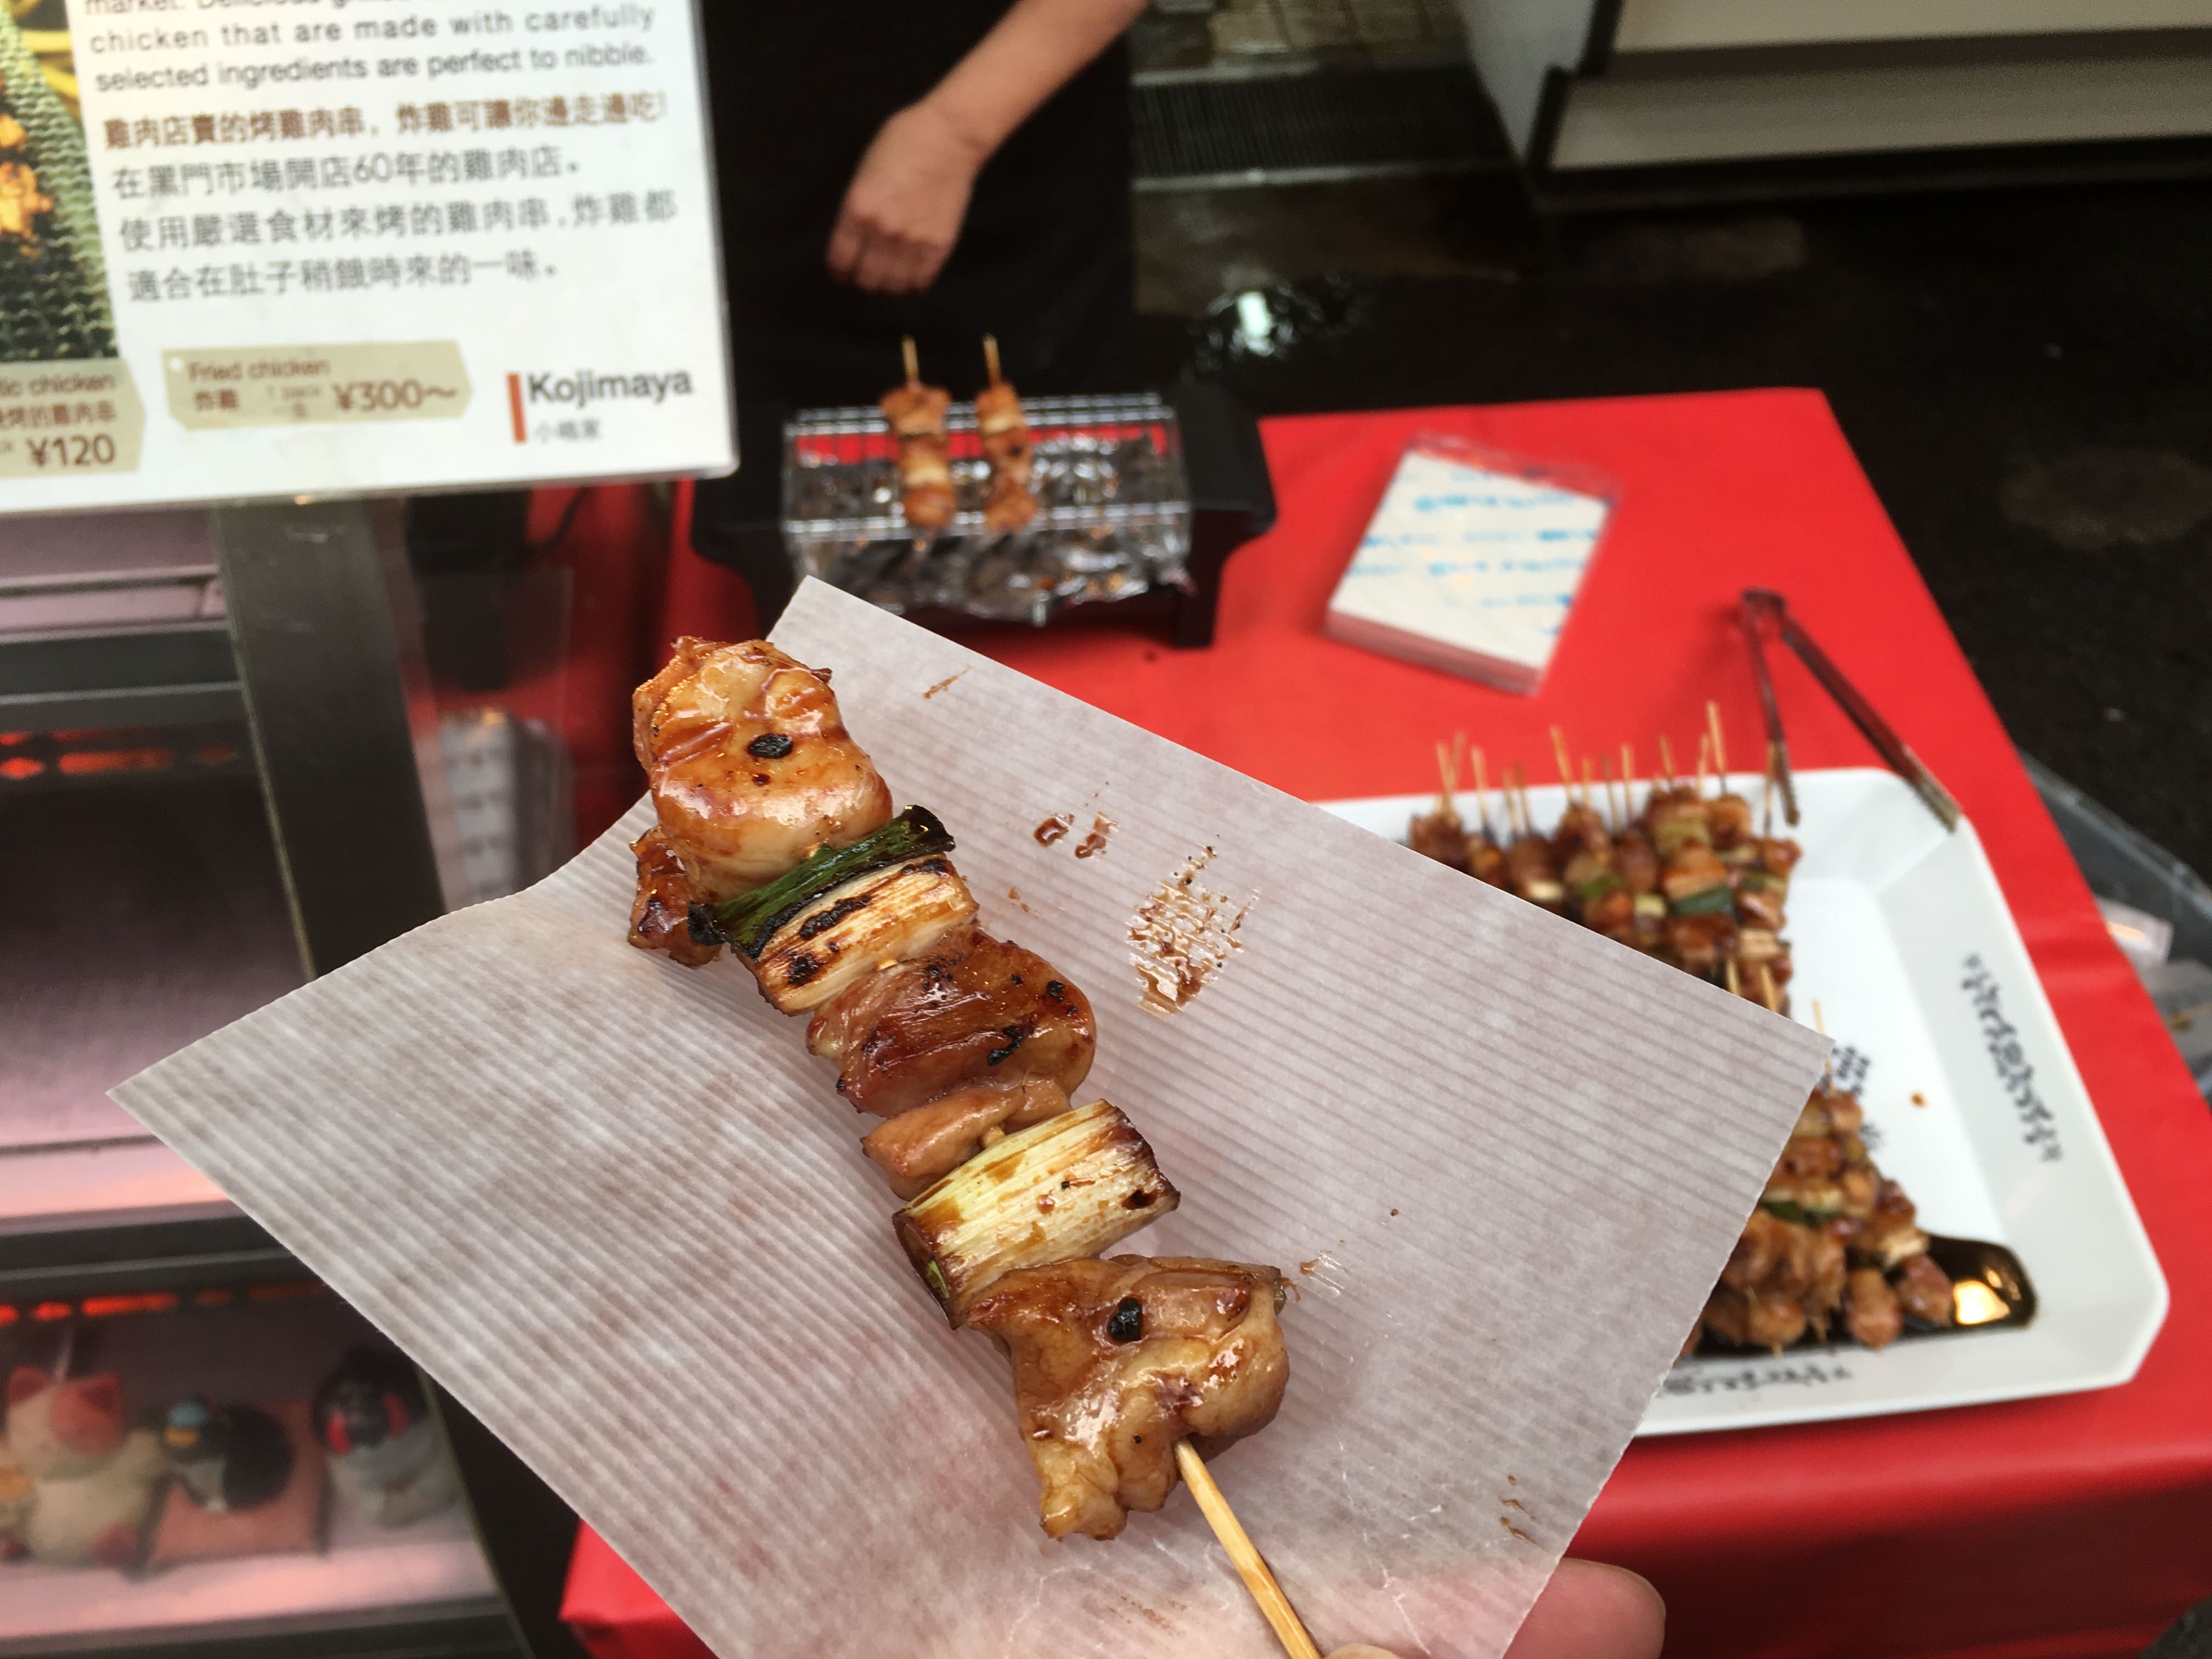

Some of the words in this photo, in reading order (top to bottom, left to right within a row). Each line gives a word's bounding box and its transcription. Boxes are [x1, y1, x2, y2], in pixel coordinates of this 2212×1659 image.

[89, 25, 208, 54] chicken
[222, 21, 281, 46] that
[295, 22, 342, 42] are
[354, 15, 437, 39] made
[448, 9, 514, 34] with
[525, 4, 656, 33] carefully
[95, 66, 209, 92] selected
[218, 57, 368, 90] ingredients
[377, 57, 419, 78] are
[427, 48, 521, 80] perfect
[529, 47, 558, 70] to
[29, 373, 116, 396] chicken
[188, 360, 242, 381] Fried
[247, 358, 331, 380] chicken
[527, 369, 693, 409] Kojimaya
[25, 434, 116, 468] ¥120
